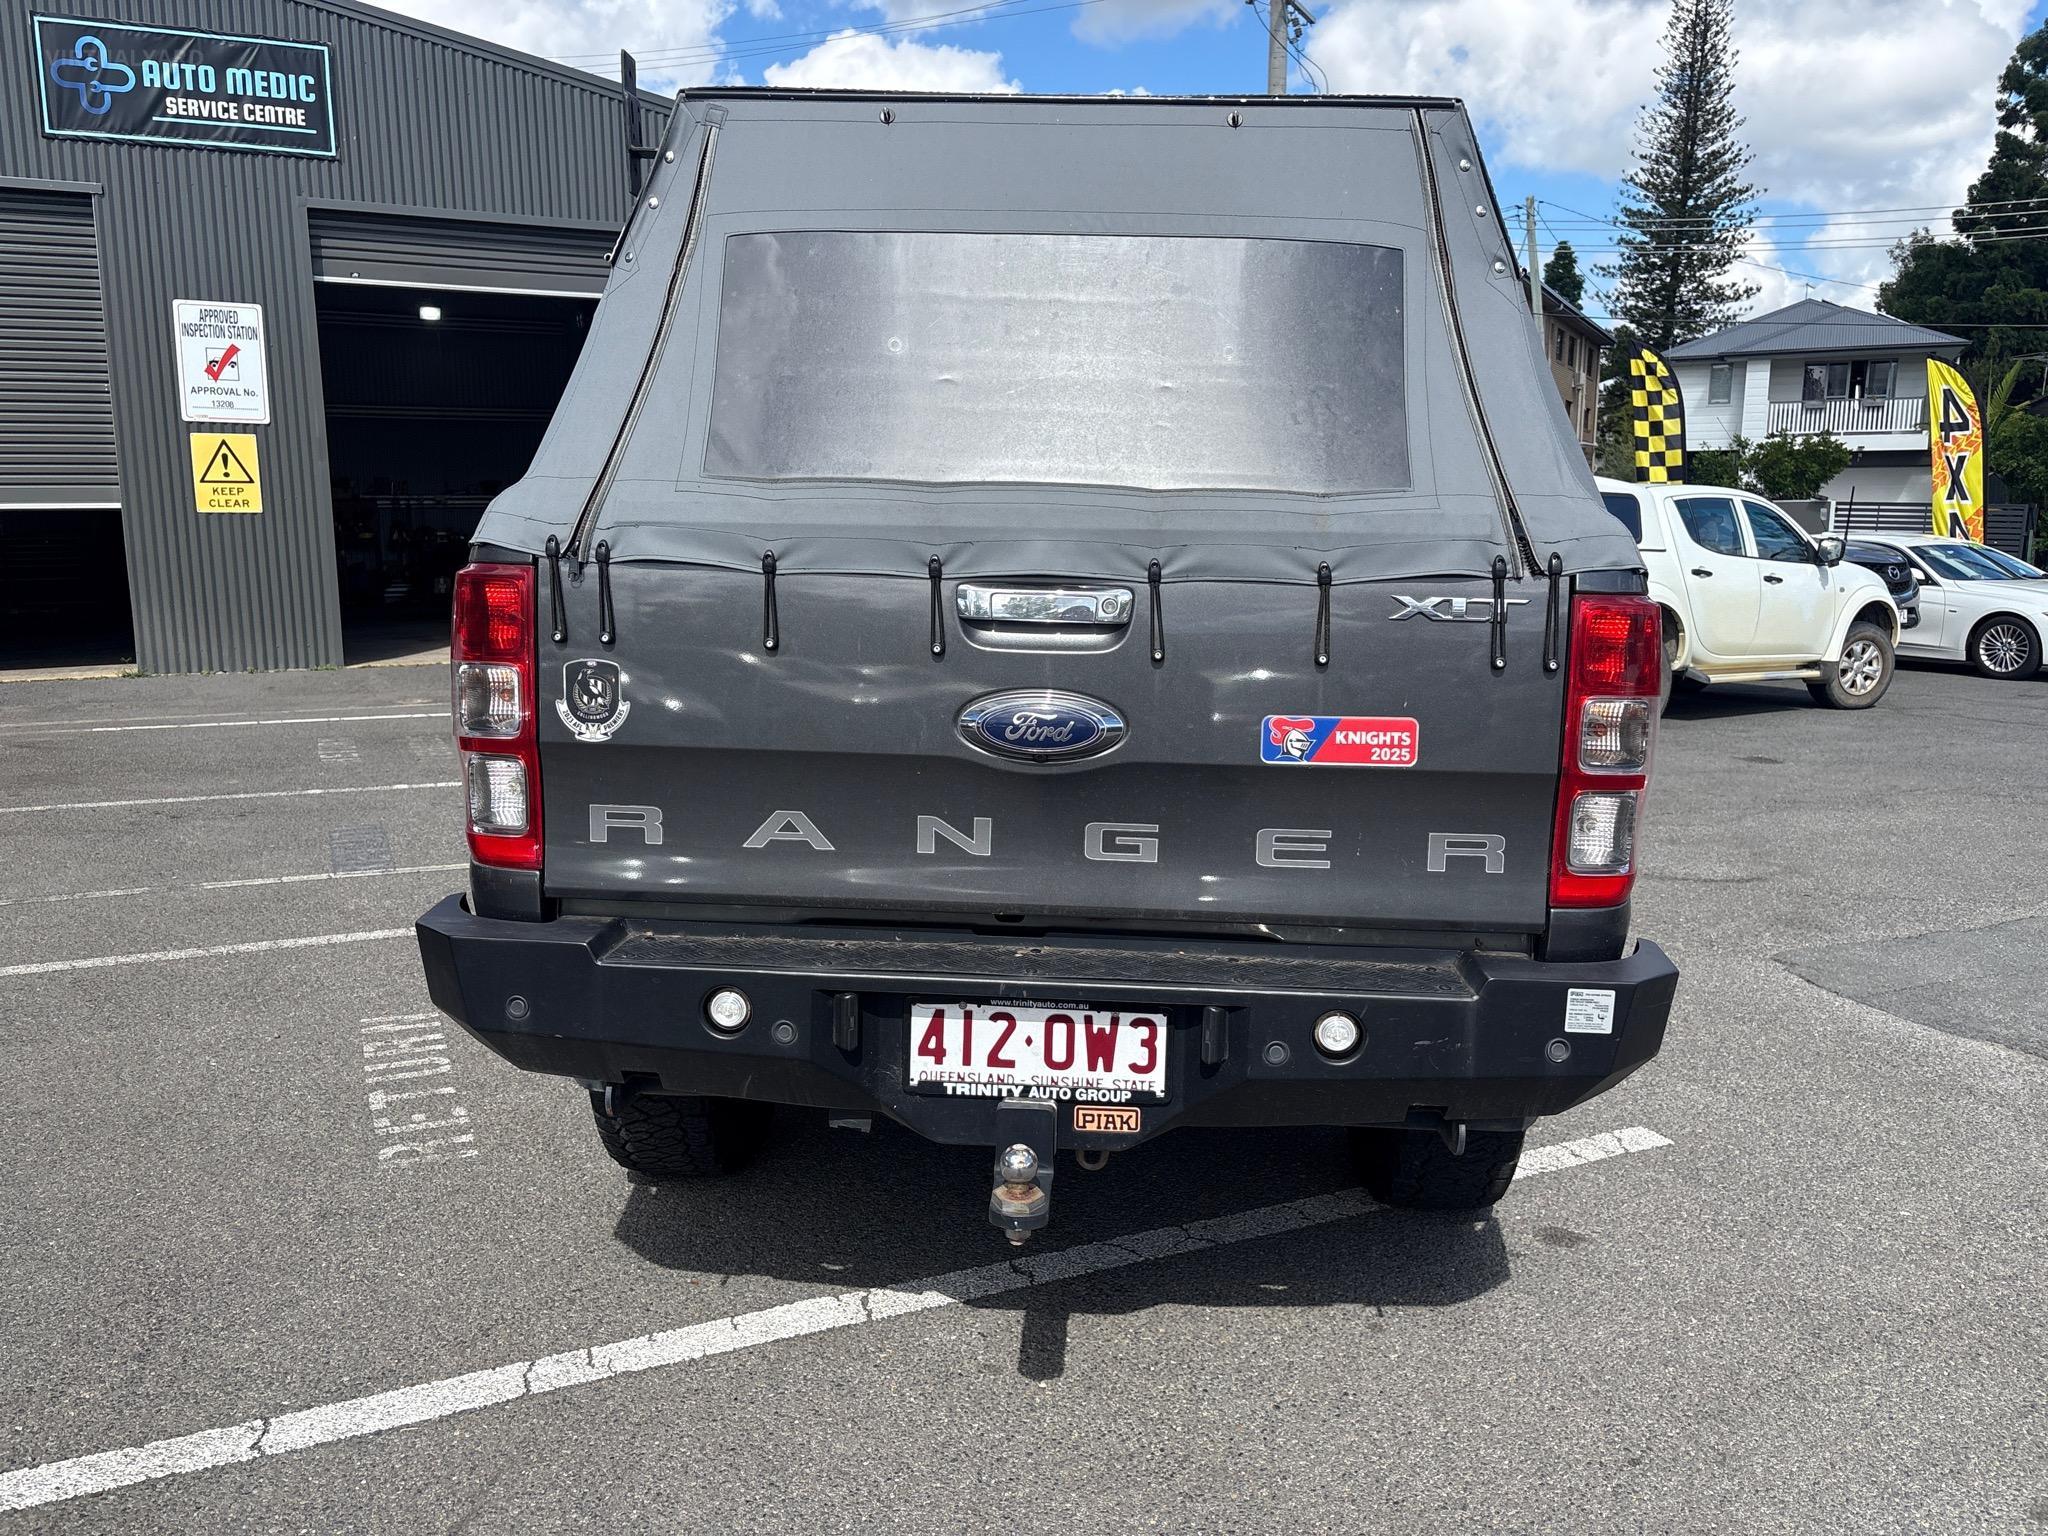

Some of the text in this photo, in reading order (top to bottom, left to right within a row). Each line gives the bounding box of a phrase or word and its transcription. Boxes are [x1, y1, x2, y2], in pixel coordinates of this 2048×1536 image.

[141, 59, 316, 103] AUTO MEDIC
[165, 96, 306, 127] SERVICE CENTRE
[199, 308, 239, 324] APPROVED
[181, 322, 258, 341] INSPECTION STATION
[190, 386, 259, 397] APPROVAL No.
[212, 487, 245, 496] KEEP
[208, 498, 250, 508] CLEAR
[1388, 594, 1532, 622] XLT
[1004, 711, 1075, 742] Ford
[1335, 730, 1411, 746] KNIGHTS
[1370, 747, 1411, 761] 2025
[589, 803, 1506, 874] RANGER
[990, 999, 1089, 1011] www.trinityauto.com.au
[943, 1082, 1132, 1103] TRINITY AUTO GROUP
[1081, 1111, 1134, 1131] PIAK
